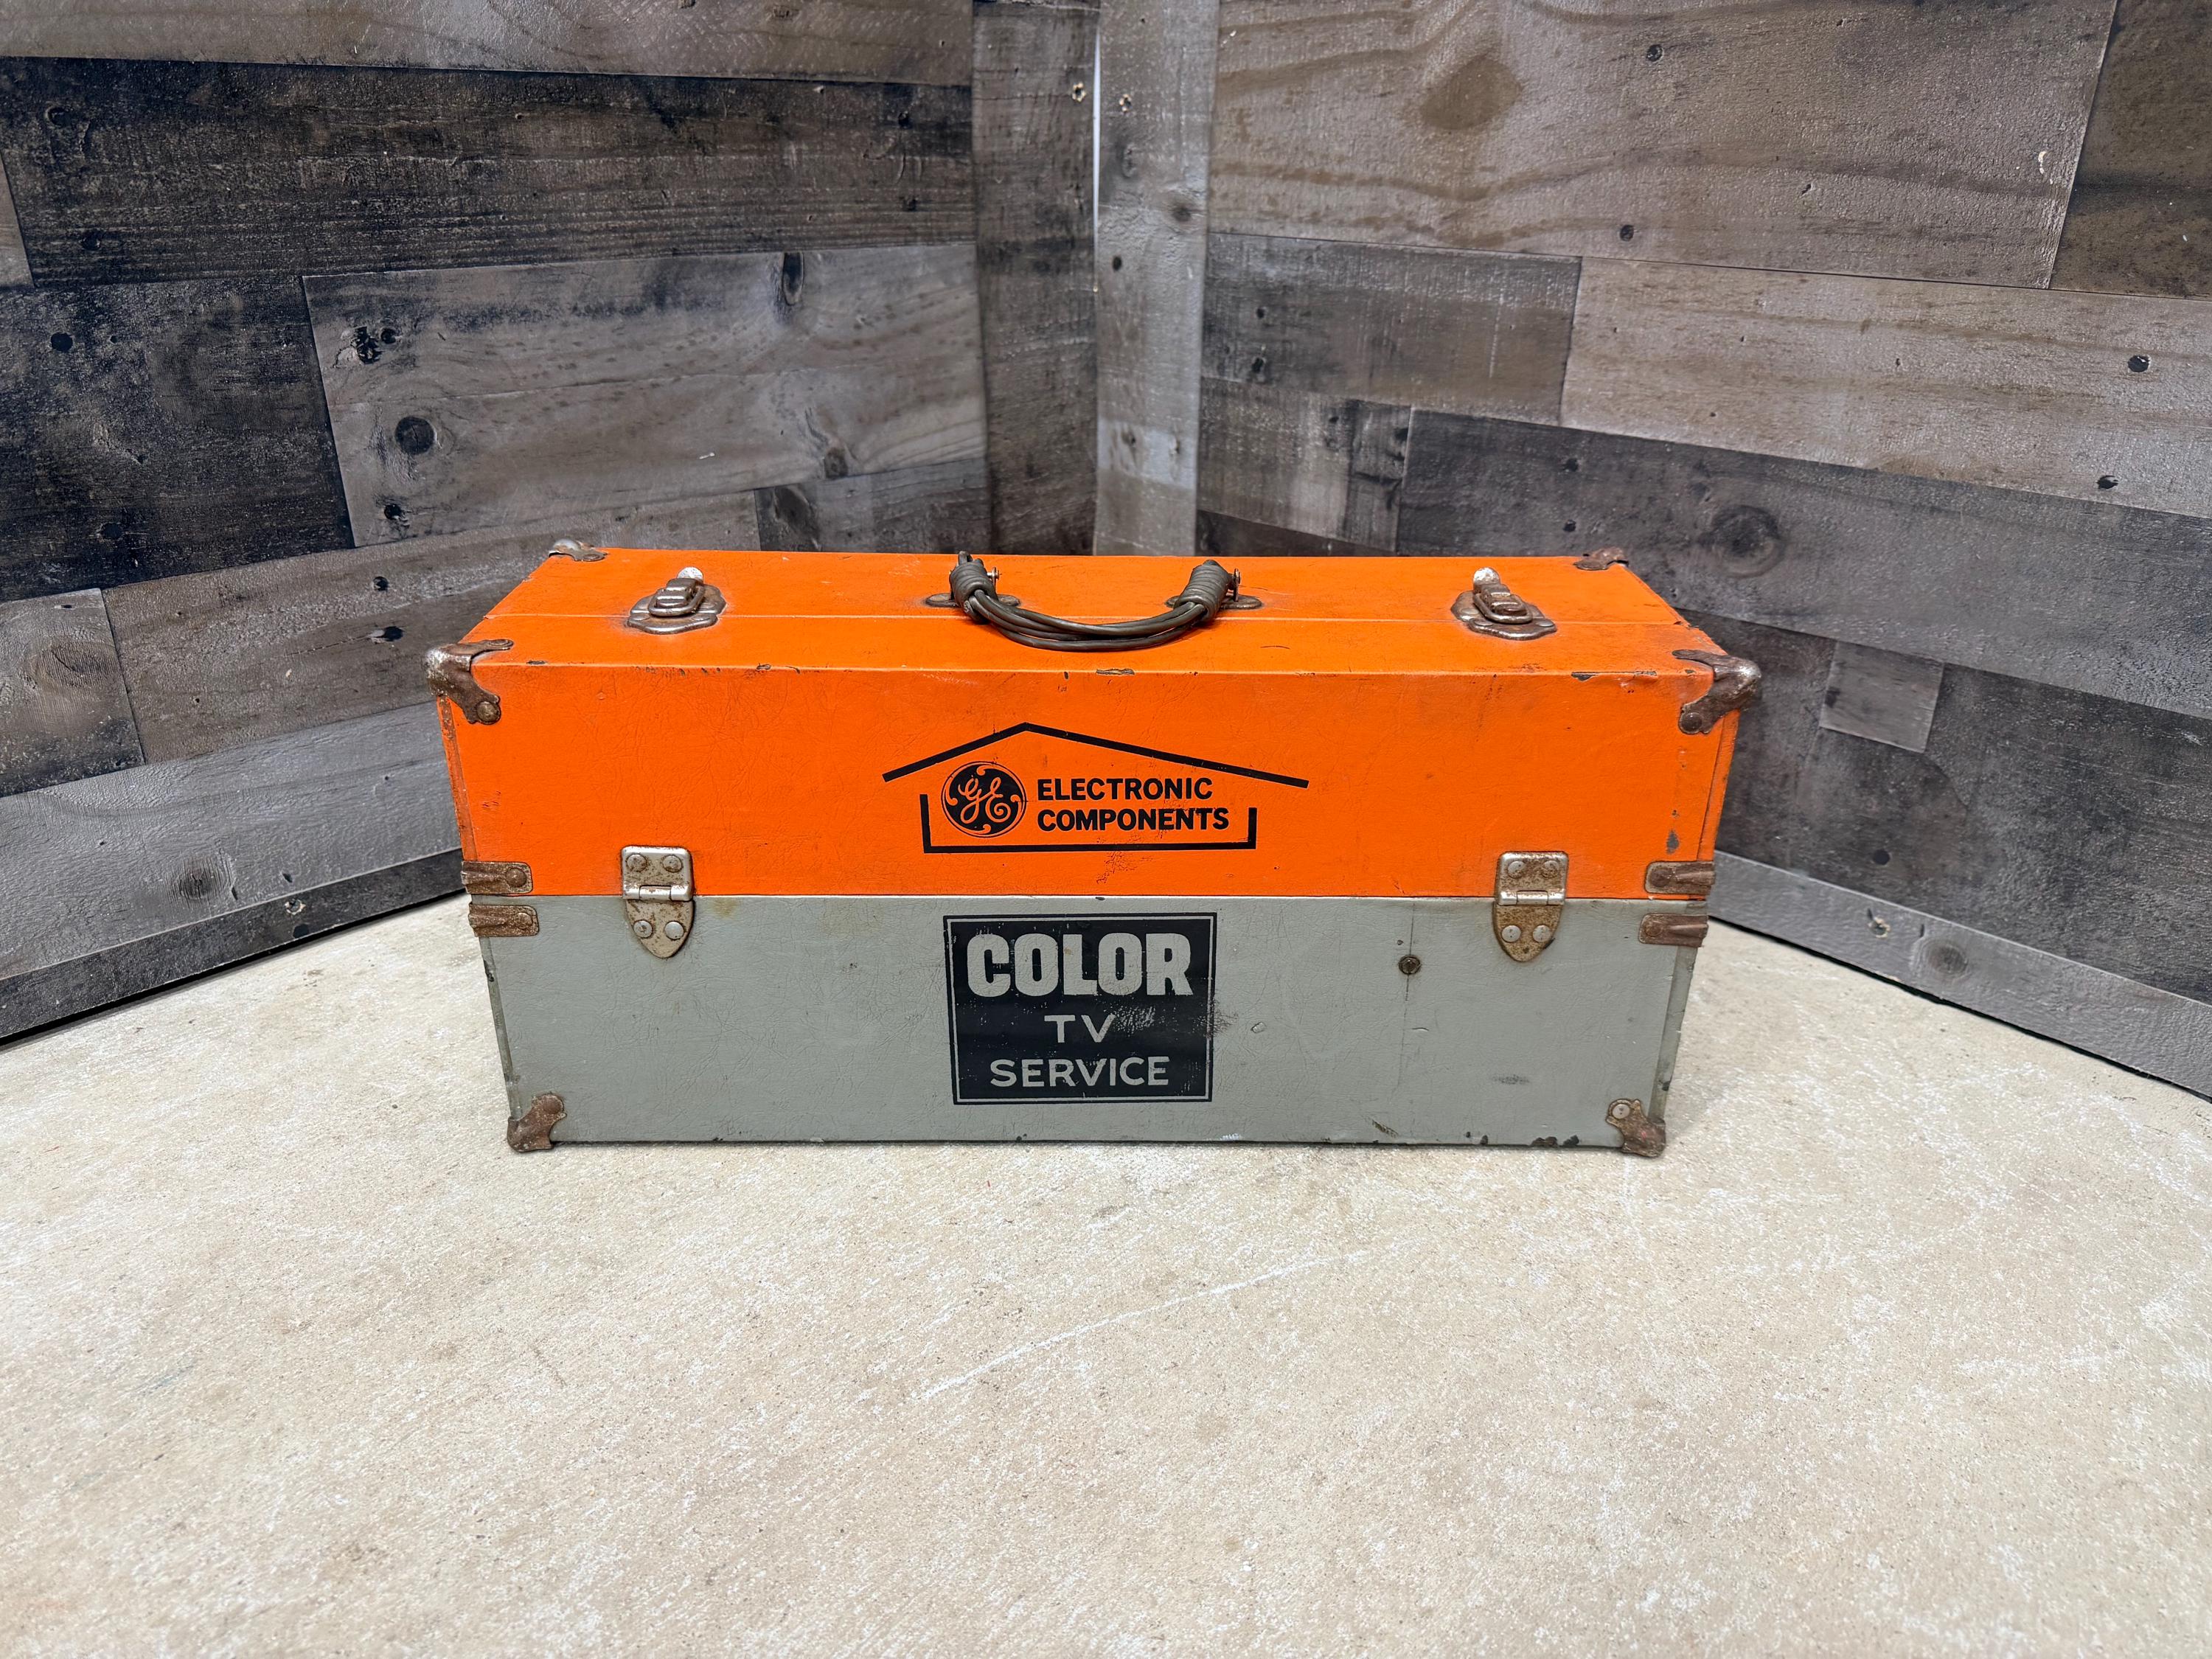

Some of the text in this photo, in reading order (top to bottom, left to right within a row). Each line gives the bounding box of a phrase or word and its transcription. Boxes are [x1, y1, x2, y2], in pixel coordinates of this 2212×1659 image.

[1037, 778, 1213, 800] ELECTRONIC
[1037, 807, 1229, 832] COMPONENTS
[967, 933, 1193, 997] COLOR
[1044, 1014, 1115, 1043] TV
[990, 1056, 1169, 1088] SERVICE
